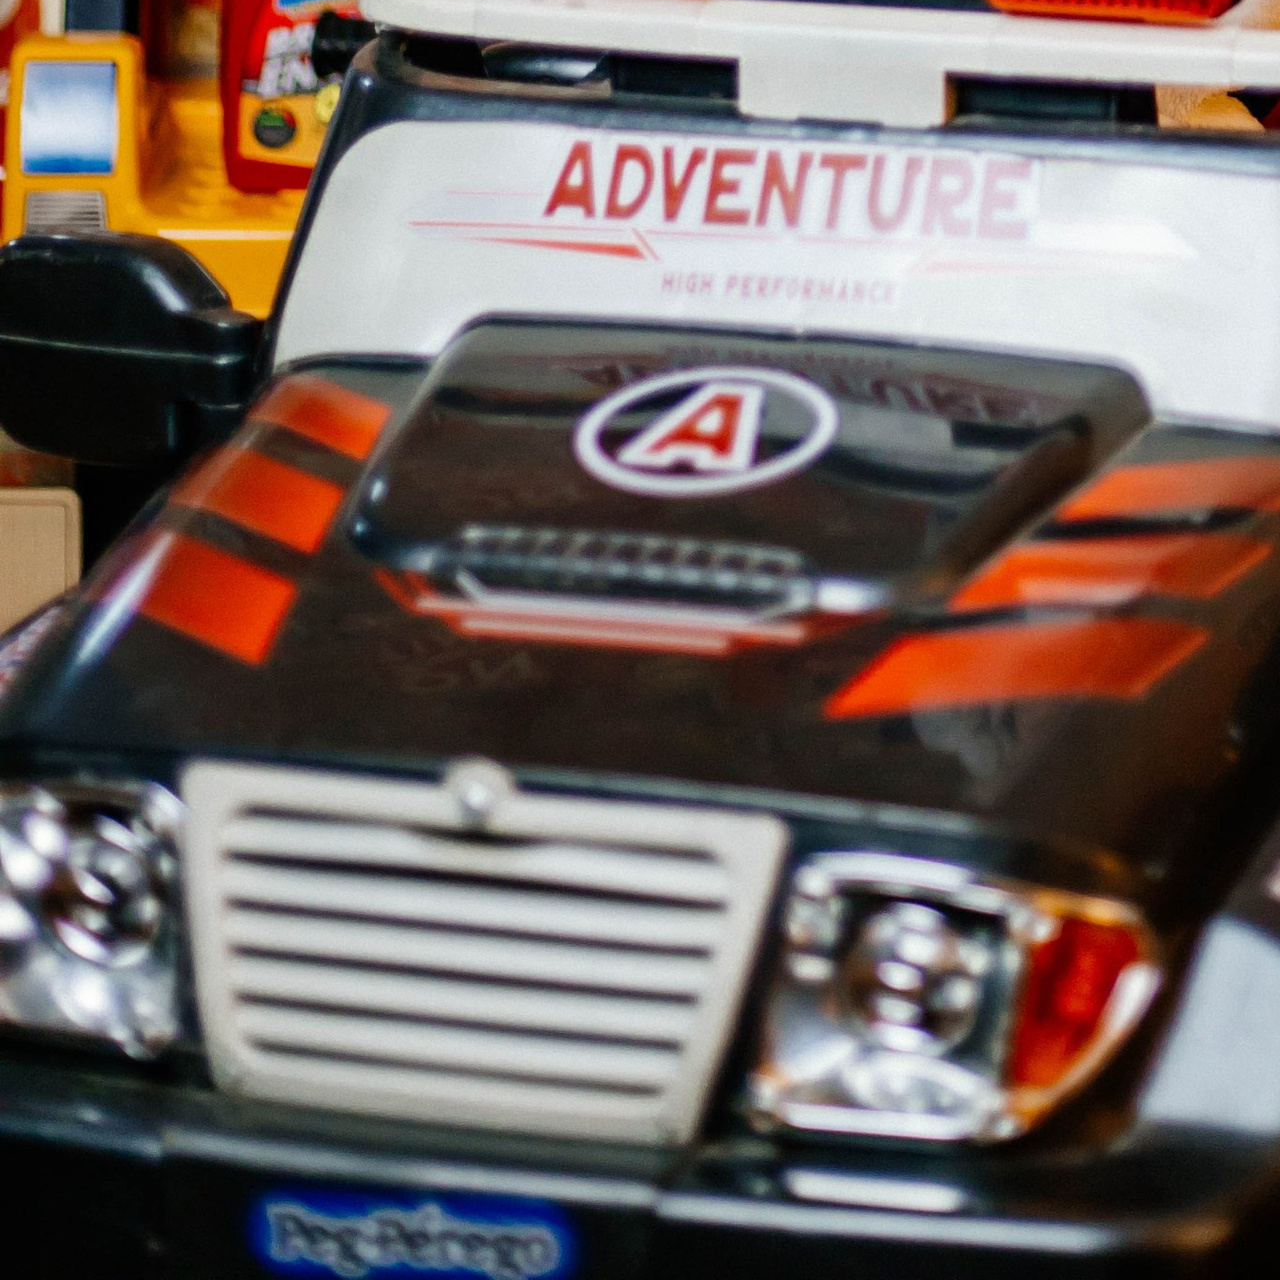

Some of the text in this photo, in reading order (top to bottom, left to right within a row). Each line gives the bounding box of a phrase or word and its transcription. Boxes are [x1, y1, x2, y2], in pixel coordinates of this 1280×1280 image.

[541, 139, 1036, 241] ADVENTURE
[660, 271, 714, 295] HIGH
[612, 378, 766, 474] A
